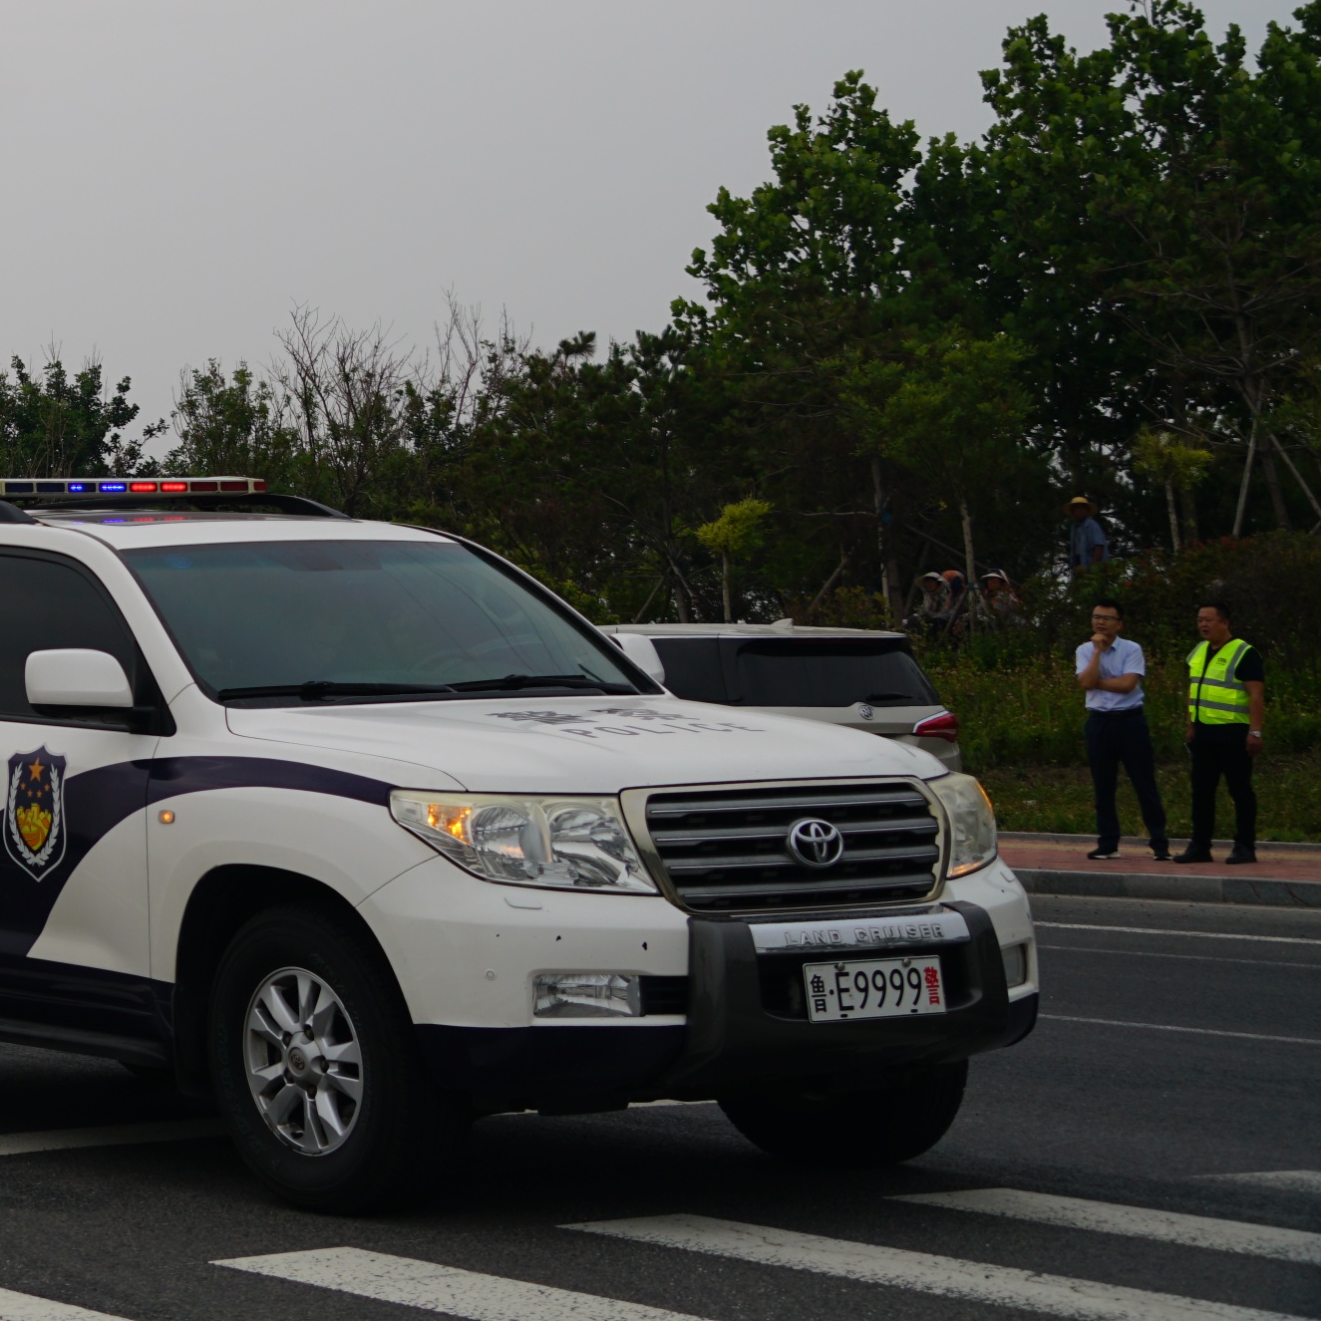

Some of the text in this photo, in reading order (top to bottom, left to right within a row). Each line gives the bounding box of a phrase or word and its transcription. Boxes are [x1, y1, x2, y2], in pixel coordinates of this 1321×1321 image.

[560, 722, 765, 739] POLICE
[784, 923, 945, 945] LAND CRUISER
